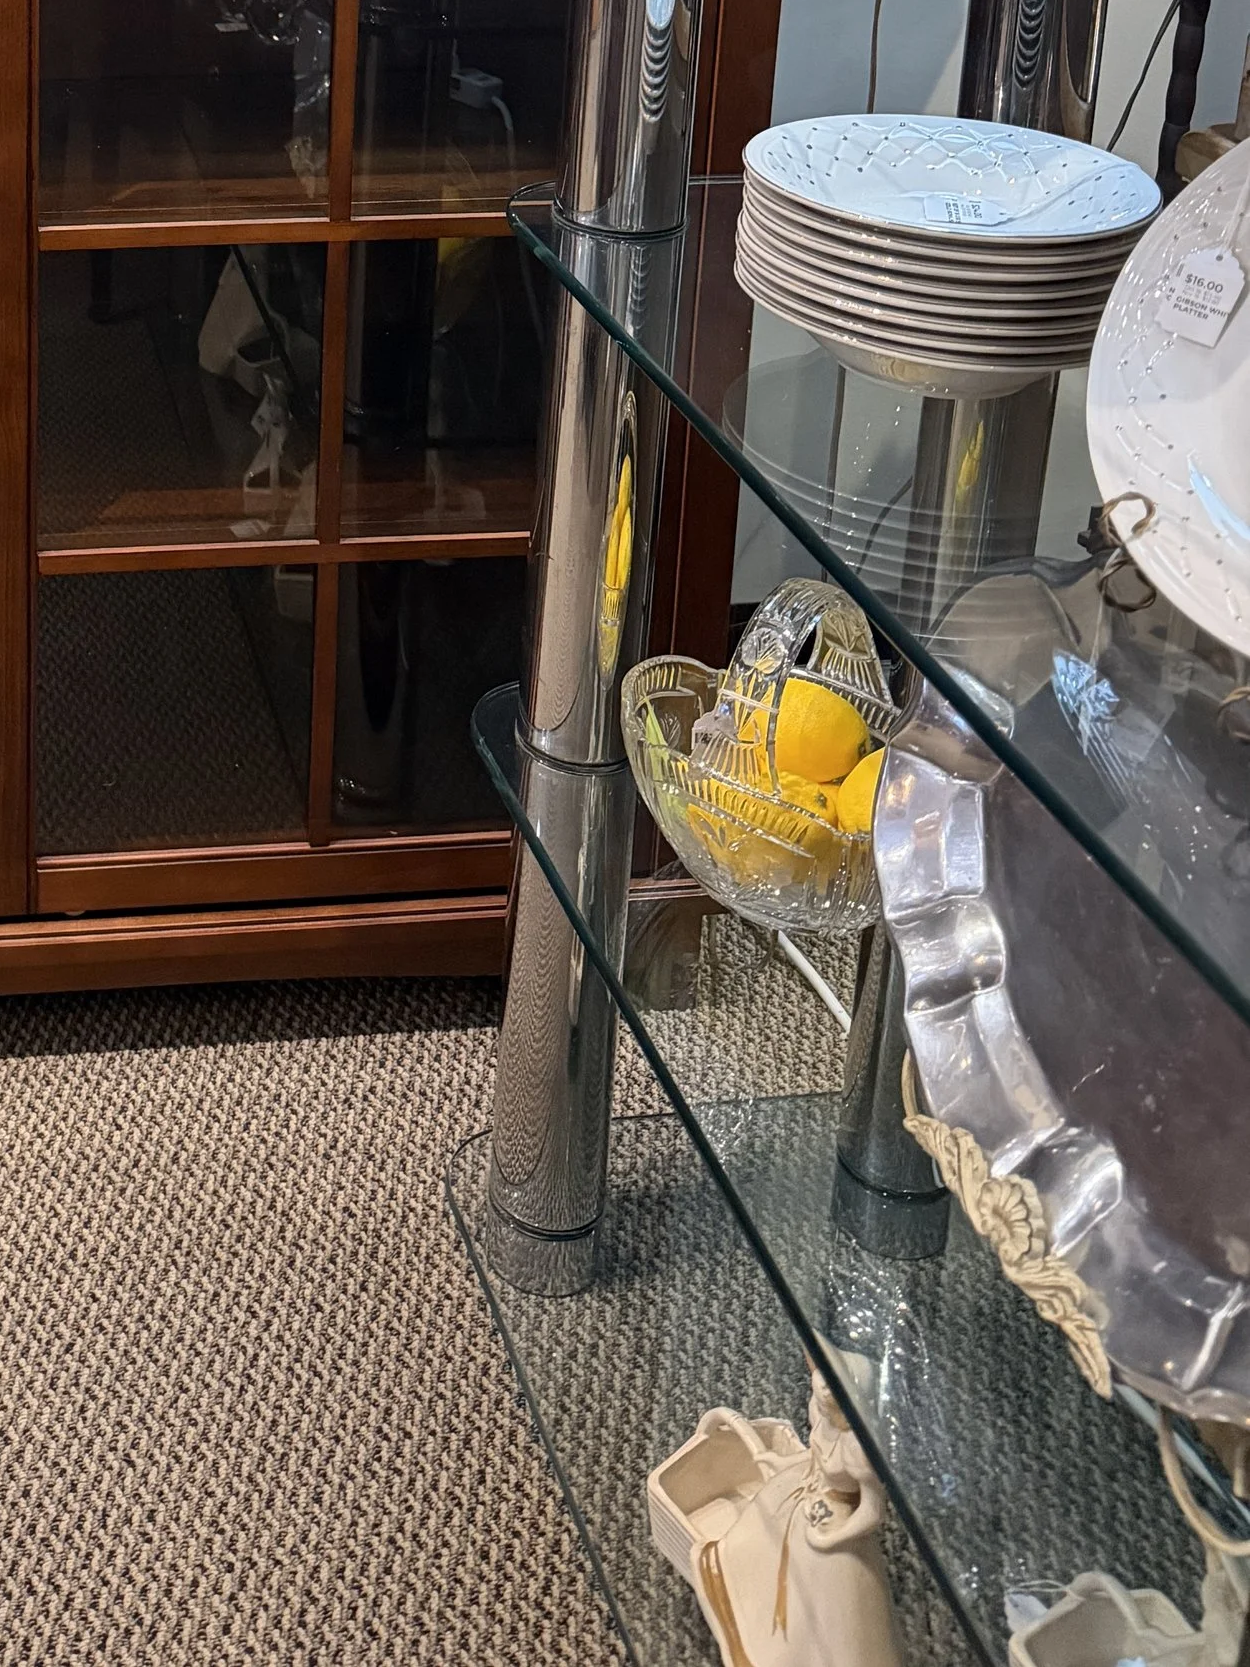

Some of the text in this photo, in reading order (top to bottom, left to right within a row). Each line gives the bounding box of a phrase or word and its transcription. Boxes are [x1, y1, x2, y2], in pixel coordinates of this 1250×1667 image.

[1184, 273, 1224, 294] $16.00
[1172, 302, 1209, 320] PLATTER
[1175, 295, 1208, 312] GIBSON
[1209, 306, 1229, 319] WHI
